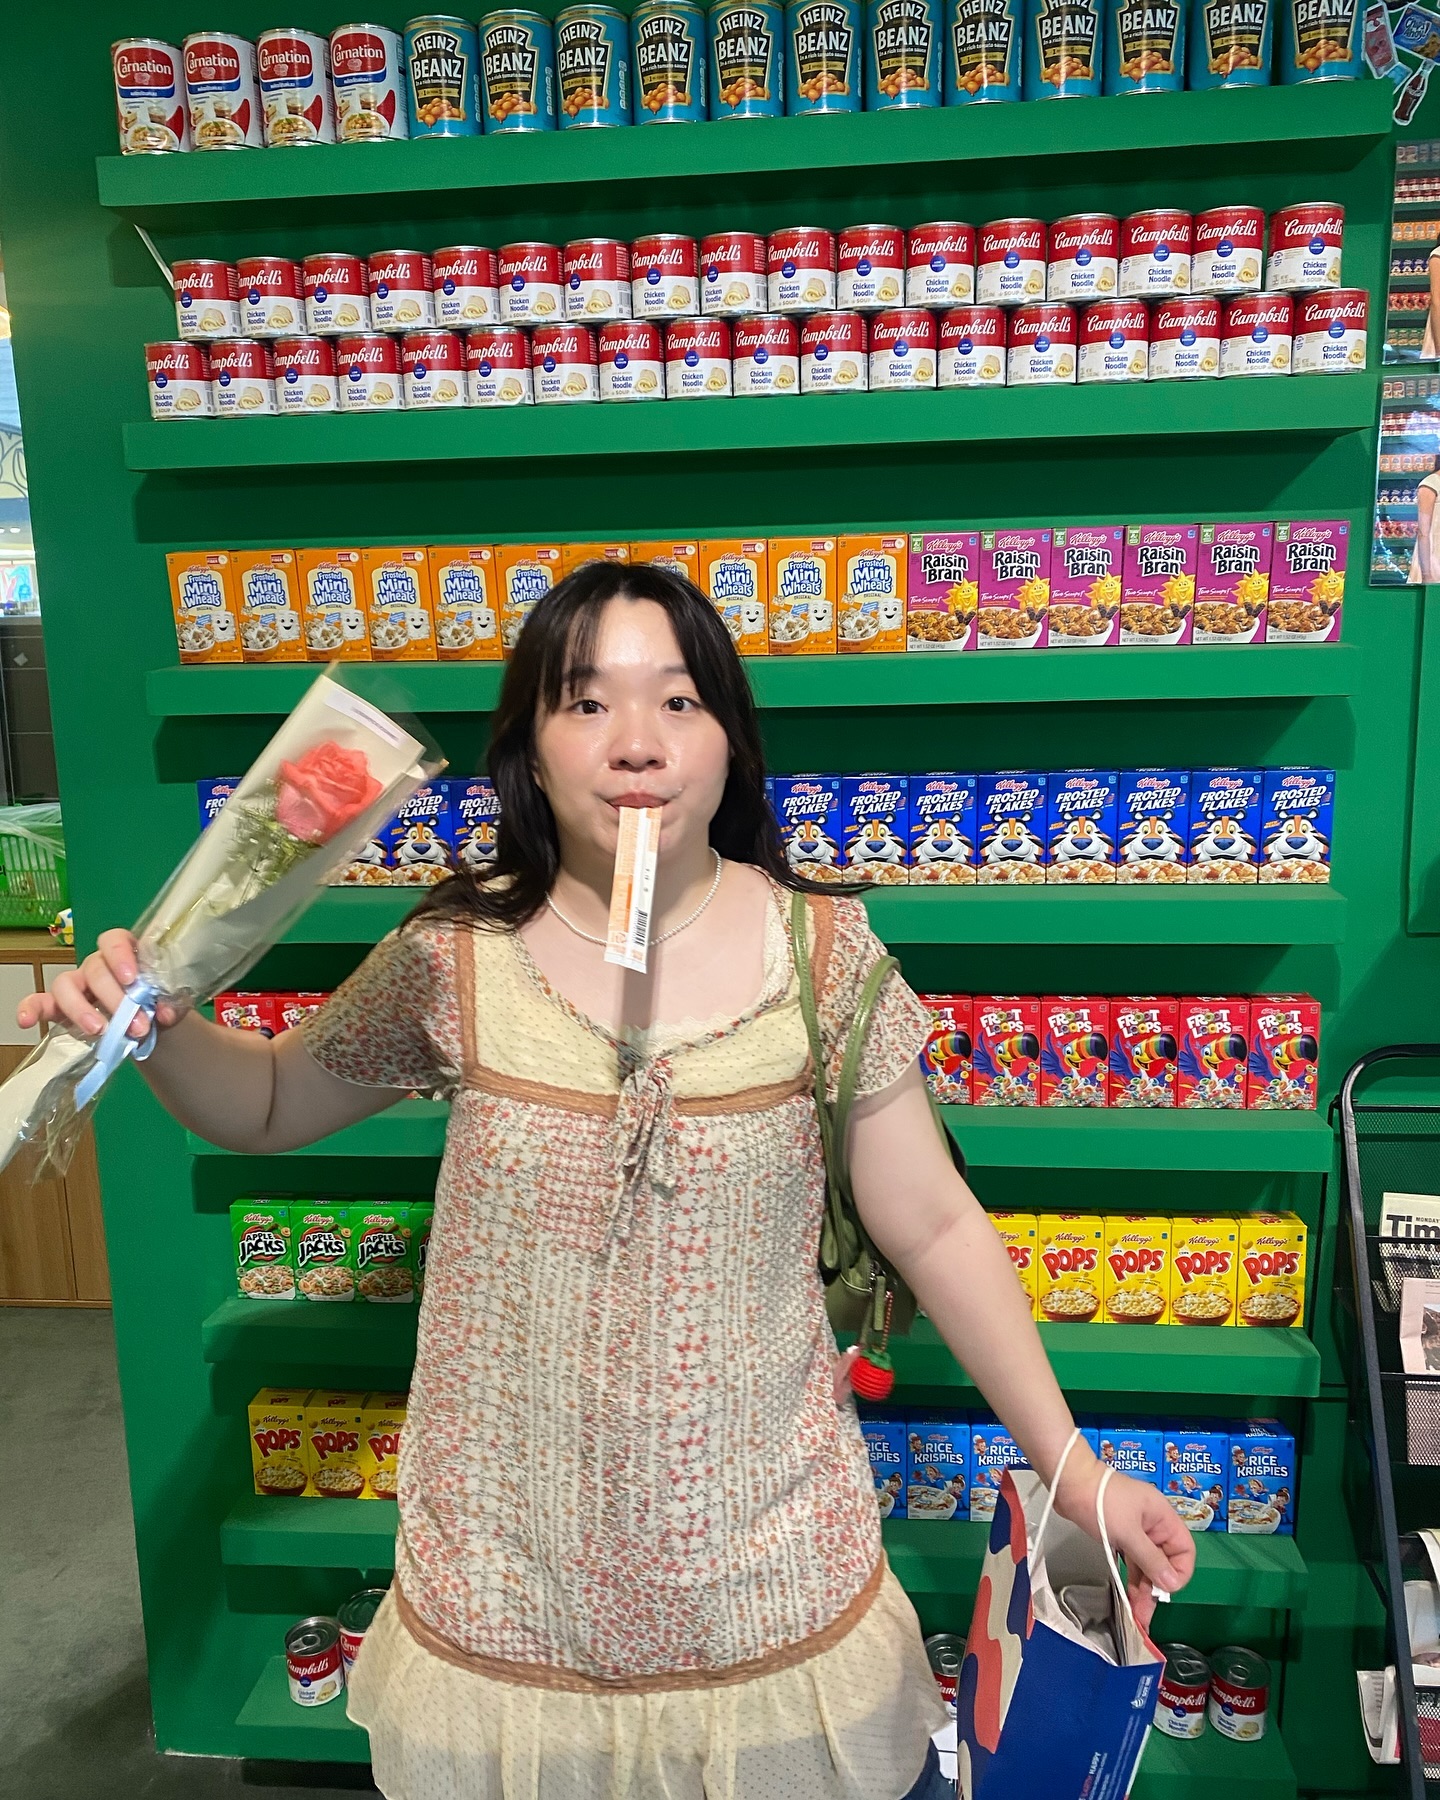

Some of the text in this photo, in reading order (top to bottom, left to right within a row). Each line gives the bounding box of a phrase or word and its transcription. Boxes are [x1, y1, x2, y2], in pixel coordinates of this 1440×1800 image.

[803, 8, 844, 26] HEINZ
[882, 2, 922, 21] HEINZ
[962, 0, 1002, 18] HEINZ
[644, 19, 683, 38] HEINZ
[722, 14, 762, 33] HEINZ
[1042, 15, 1094, 39] BEANZ
[1121, 8, 1175, 32] BEANZ
[488, 29, 527, 48] HEINZ
[562, 25, 599, 41] HEINZ
[878, 26, 928, 50] BEANZ
[957, 21, 1008, 46] BEANZ
[416, 36, 455, 53] HEINZ
[718, 37, 767, 60] BEANZ
[799, 31, 848, 54] BEANZ
[260, 48, 310, 71] Carnation
[334, 43, 384, 67] Carnation
[560, 47, 605, 70] BEANZ
[640, 42, 688, 66] BEANZ
[118, 56, 171, 78] Carnation
[186, 52, 237, 74] Carnation
[413, 58, 462, 80] BEANZ
[486, 52, 533, 75] BEANZ
[1131, 223, 1189, 244] Campbell's
[1197, 220, 1257, 242] Campbell's
[1284, 215, 1342, 238] Campbell's
[911, 235, 968, 256] Campbell's
[983, 231, 1040, 252] Campbell's
[1055, 229, 1112, 250] Campbell's
[632, 248, 683, 269] Campbell's
[840, 240, 894, 260] Campbell's
[1148, 268, 1172, 276] Chicken
[1149, 275, 1171, 283] Noodle
[778, 284, 800, 293] Chicken
[926, 278, 950, 286] Chicken
[779, 291, 799, 299] Noodle
[376, 304, 393, 312] Chicken
[376, 312, 393, 320] Noodle
[1230, 306, 1289, 326] Campbell's
[1305, 301, 1365, 322] Campbell's
[941, 318, 996, 338] Campbell's
[1014, 316, 1070, 336] Campbell's
[1087, 311, 1144, 332] Campbell's
[1158, 309, 1217, 330] Campbell's
[736, 328, 790, 348] Campbell's
[874, 320, 929, 340] Campbell's
[667, 331, 720, 351] Campbell's
[889, 362, 912, 370] Chicken
[1104, 355, 1128, 363] Chicken
[1105, 362, 1128, 370] Noodle
[681, 372, 704, 381] Chicken
[927, 538, 963, 553] Kellogg's
[998, 537, 1035, 549] Kellogg's
[1070, 533, 1107, 547] Kellogg's
[789, 551, 814, 559] Kellogg's
[993, 550, 1040, 568] Raisin
[1065, 548, 1111, 564] Raisin
[1139, 546, 1185, 563] Raisin
[1213, 544, 1259, 561] Raisin
[1287, 543, 1334, 559] Raisin
[721, 563, 745, 571] Frosted
[789, 561, 814, 570] Frosted
[859, 560, 883, 568] Frosted
[922, 554, 968, 571] Raisin
[1069, 561, 1105, 578] Bran
[1144, 559, 1179, 576] Bran
[1218, 558, 1253, 574] Bran
[1292, 556, 1329, 573] Bran
[189, 574, 212, 583] Frosted
[318, 571, 342, 581] Frosted
[717, 570, 751, 585] Mini
[785, 569, 819, 583] Mini
[854, 567, 889, 581] Mini
[927, 566, 963, 584] Bran
[998, 564, 1034, 581] Bran
[185, 581, 218, 595] Mini
[315, 578, 348, 593] Mini
[714, 583, 753, 598] Wheats
[782, 581, 821, 596] Wheats
[852, 579, 891, 594] Wheats
[184, 593, 221, 606] Wheats
[314, 590, 351, 604] Wheats
[858, 782, 890, 794] Kellogg's
[1282, 776, 1315, 788] Kellogg's
[783, 792, 833, 808] FROSTED
[850, 791, 901, 807] FROSTED
[985, 789, 1039, 806] FROSTED
[1126, 787, 1181, 804] FROSTED
[1271, 785, 1327, 803] FROSTED
[786, 802, 827, 816] FLAKES
[853, 801, 896, 815] FLAKES
[988, 800, 1034, 815] FLAKES
[1130, 798, 1175, 812] FLAKES
[1274, 796, 1321, 810] FLAKES
[979, 1009, 1022, 1028] FROOT
[1047, 1008, 1090, 1028] FROOT
[1116, 1009, 1160, 1029] FROOT
[1257, 1009, 1301, 1030] FROOT
[985, 1022, 1024, 1038] LOOPS
[1053, 1021, 1092, 1038] LOOPS
[1121, 1021, 1161, 1038] LOOPS
[1262, 1020, 1302, 1039] LOOPS
[244, 1213, 274, 1223] Kellogg's
[246, 1232, 273, 1241] APPLE
[305, 1233, 333, 1242] APPLE
[1055, 1233, 1086, 1244] Kellogg's
[1257, 1236, 1288, 1246] Kellogg's
[239, 1240, 285, 1266] JACKS
[298, 1240, 345, 1268] JACKS
[1041, 1246, 1098, 1281] POPS
[1107, 1247, 1165, 1284] POPS
[1242, 1250, 1300, 1285] POPS
[253, 1428, 301, 1458] POPS
[925, 1441, 953, 1455] RICE
[913, 1452, 965, 1466] KRISPIES
[1183, 1453, 1210, 1463] RICE
[1249, 1456, 1277, 1466] RICE
[1171, 1463, 1221, 1474] KRISPIES
[1237, 1466, 1288, 1477] KRISPIES
[287, 1658, 328, 1676] Campbell's
[1211, 1679, 1256, 1709] Campbell's
